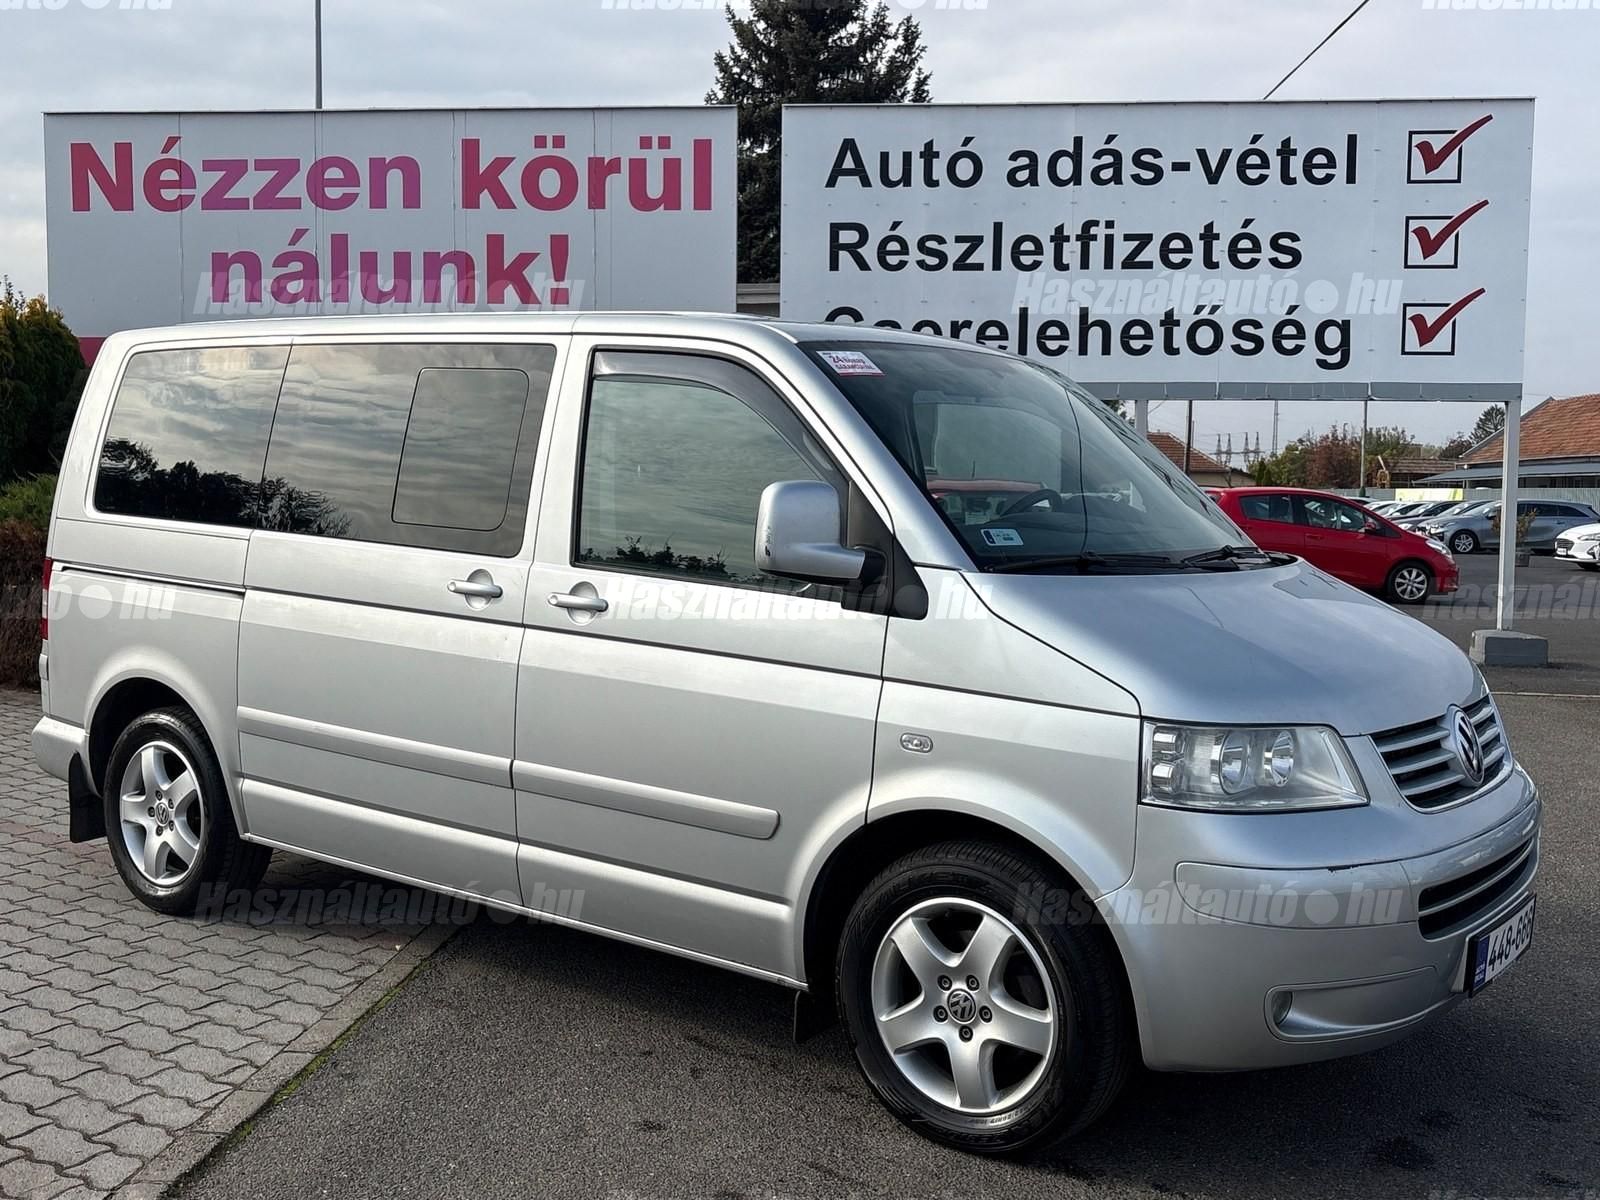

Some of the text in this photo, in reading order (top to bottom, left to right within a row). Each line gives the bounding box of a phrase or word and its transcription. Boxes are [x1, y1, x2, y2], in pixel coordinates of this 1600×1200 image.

[70, 134, 713, 212] Nézzen körül
[825, 133, 1358, 189] Autó adás-vétel
[211, 228, 569, 305] nálunk!
[828, 217, 1303, 272] Részletfizetés
